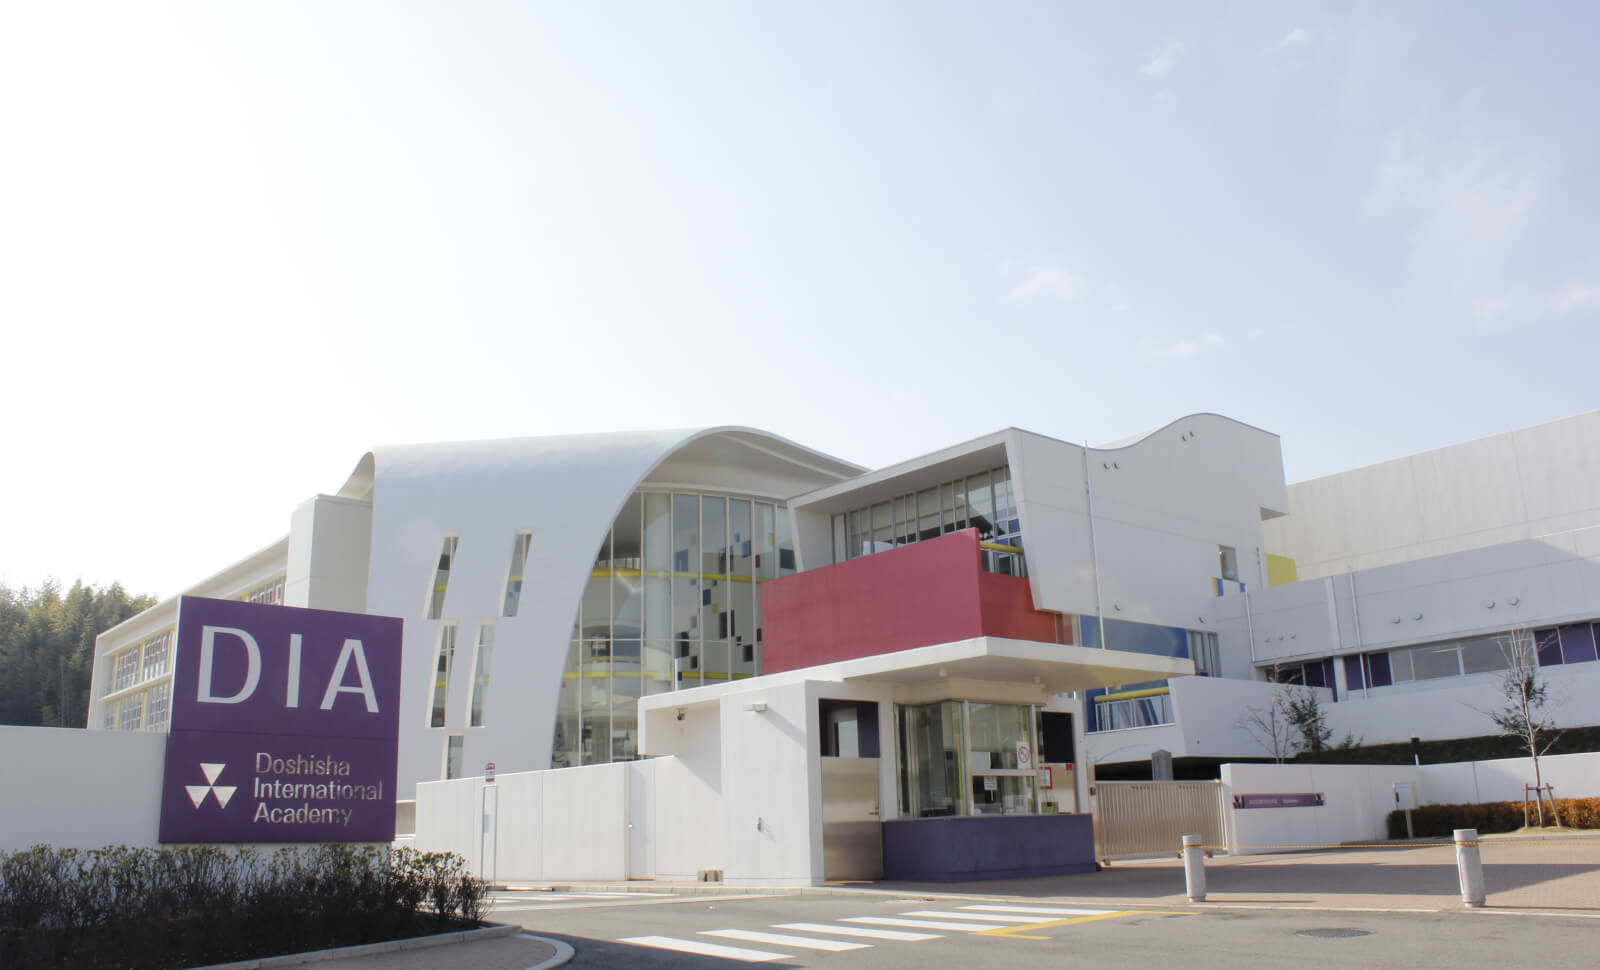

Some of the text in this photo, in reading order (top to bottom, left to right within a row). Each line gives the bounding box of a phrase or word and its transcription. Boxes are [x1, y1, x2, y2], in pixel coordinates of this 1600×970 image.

[197, 625, 379, 713] DIA
[255, 752, 350, 776] Doshisha
[253, 777, 382, 801] International
[253, 802, 352, 827] Academy
